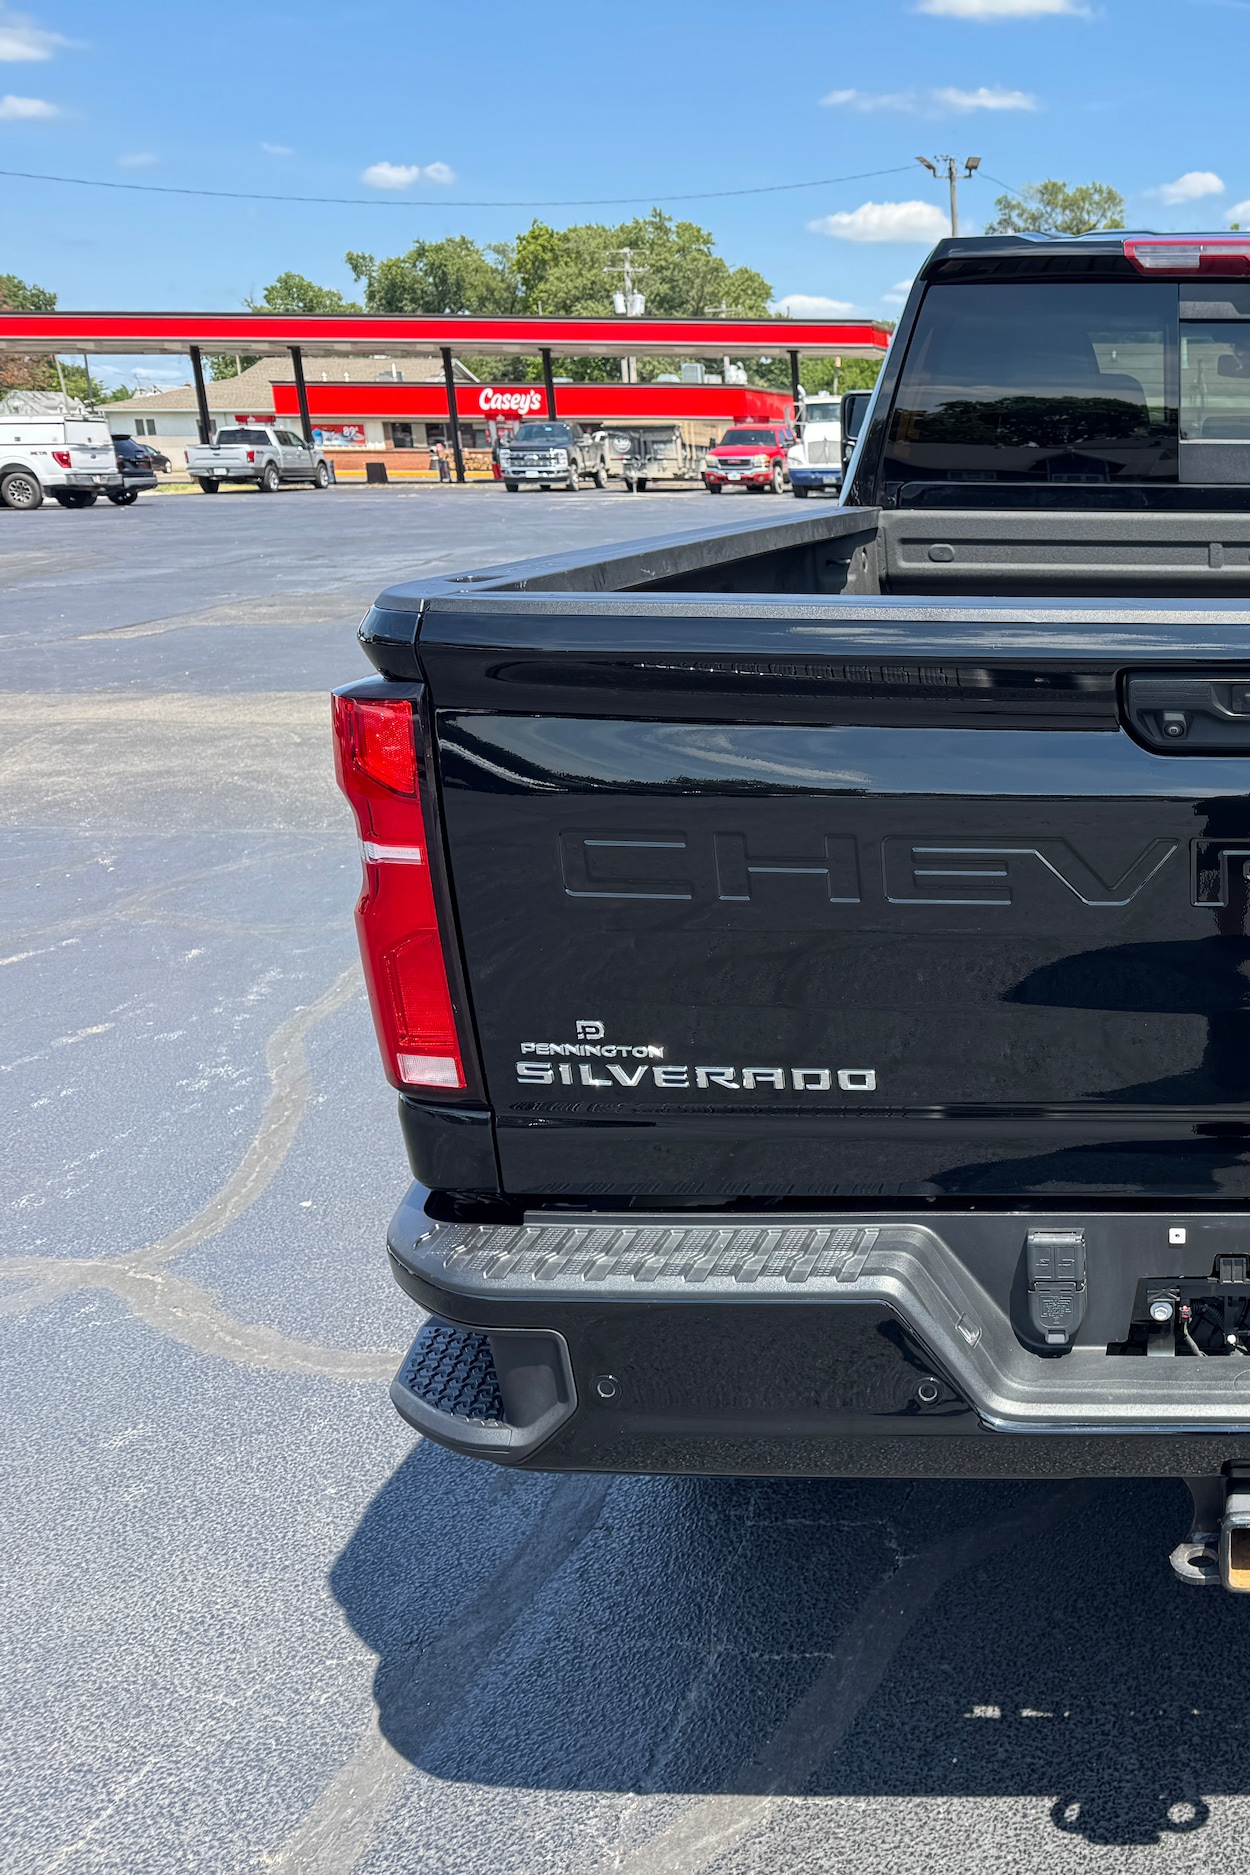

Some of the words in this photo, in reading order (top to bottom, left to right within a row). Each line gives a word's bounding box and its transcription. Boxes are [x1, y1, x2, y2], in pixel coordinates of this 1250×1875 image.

[478, 387, 542, 415] Casey's
[520, 1041, 665, 1060] PENNINGTON
[515, 1060, 878, 1092] SILVERADO
